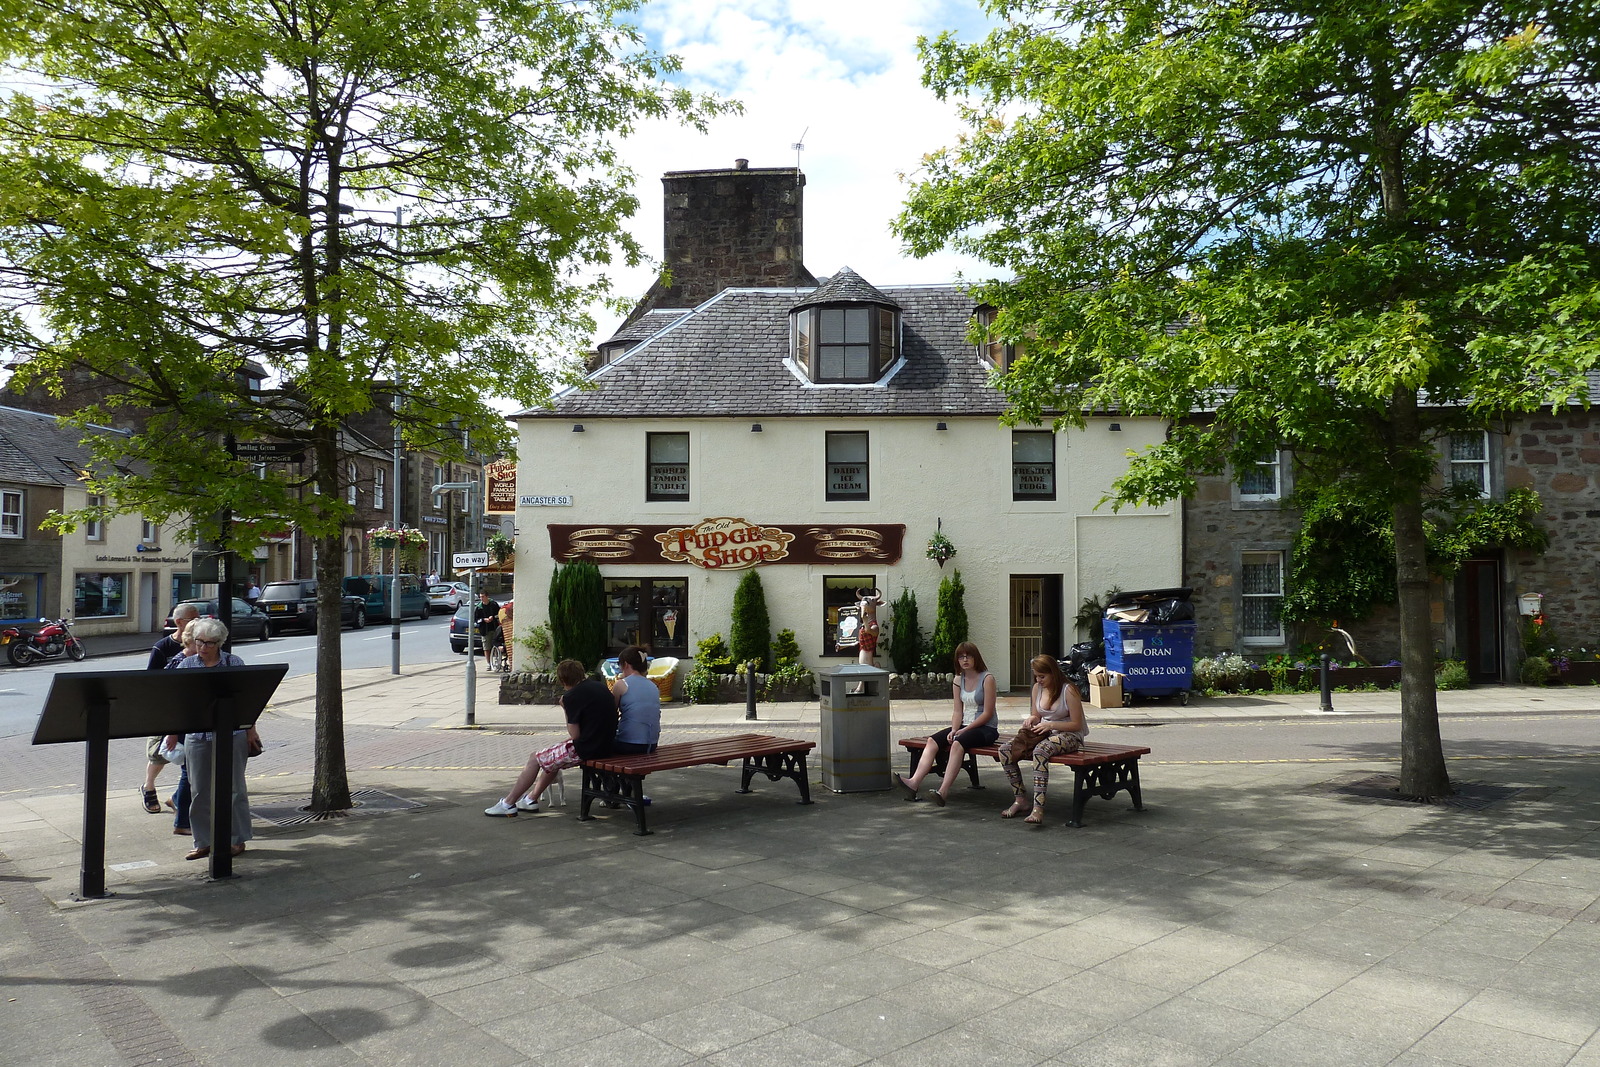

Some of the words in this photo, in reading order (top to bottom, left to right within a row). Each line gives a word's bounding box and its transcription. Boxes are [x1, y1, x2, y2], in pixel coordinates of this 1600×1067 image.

[237, 443, 258, 451] Bowling
[521, 496, 556, 505] ANCASTER
[701, 525, 714, 533] The
[715, 521, 731, 531] Old
[677, 526, 762, 553] FUDGE
[455, 556, 469, 564] One
[471, 556, 486, 565] way
[702, 544, 773, 569] SHOP
[1143, 648, 1172, 656] ORAN
[1128, 667, 1149, 676] 0800
[1149, 666, 1165, 676] 432
[1166, 666, 1187, 675] 0000
